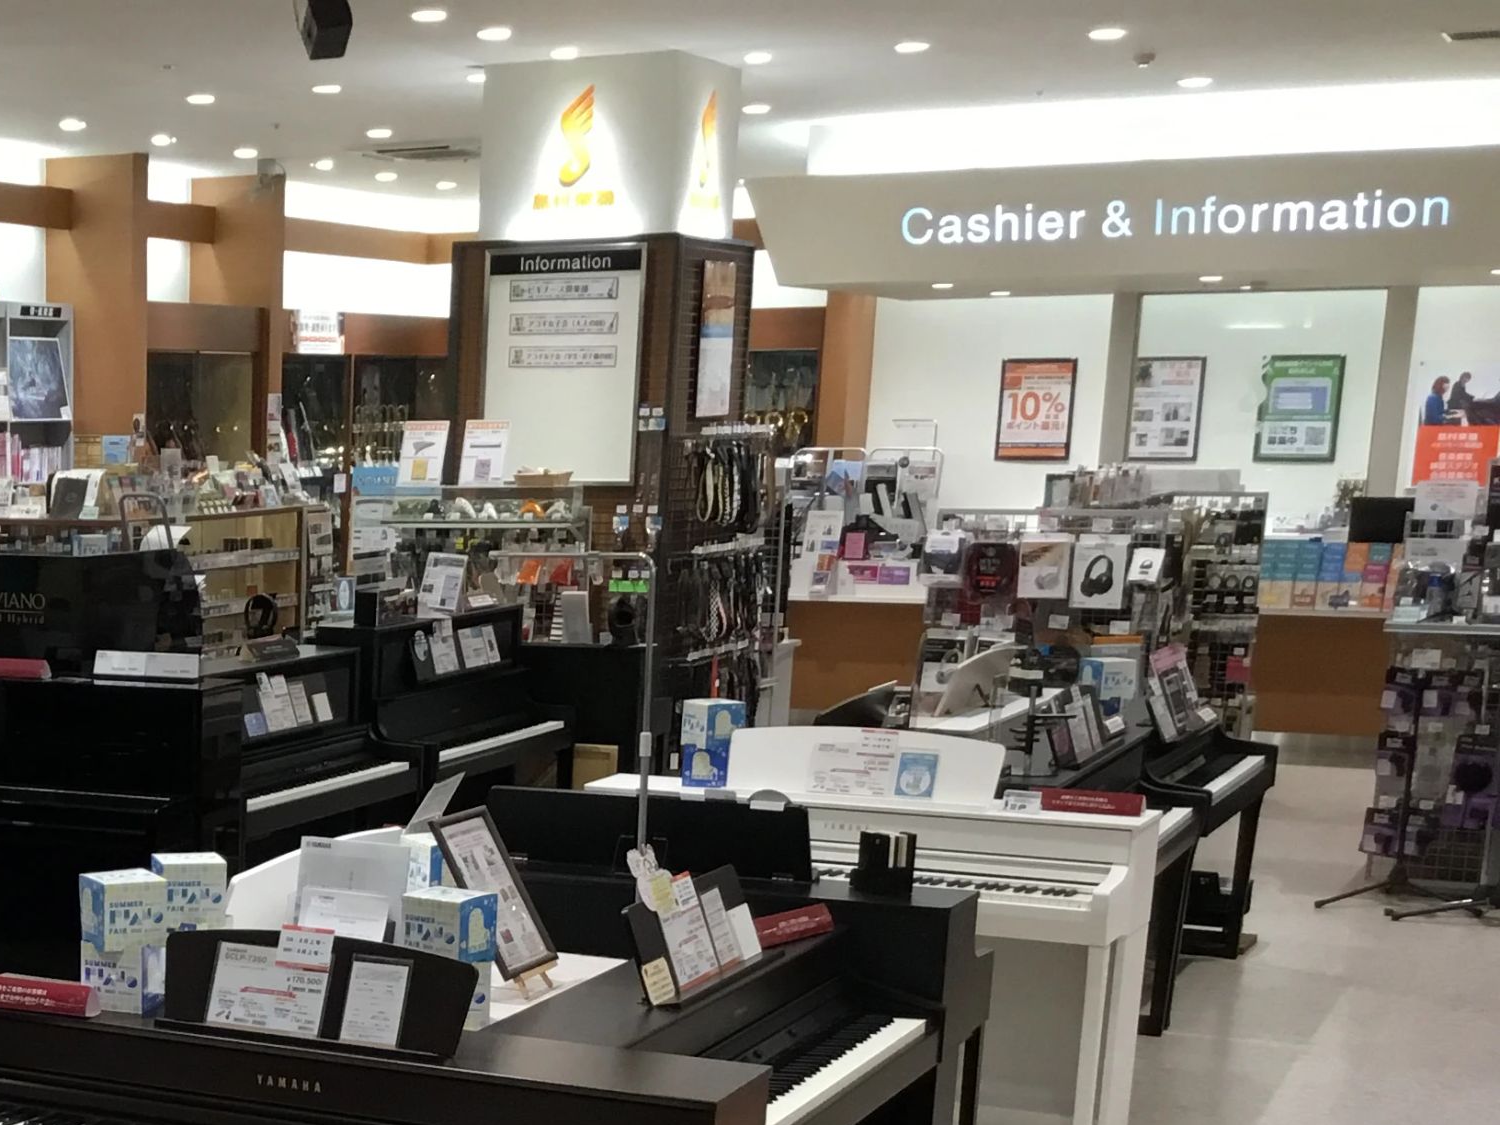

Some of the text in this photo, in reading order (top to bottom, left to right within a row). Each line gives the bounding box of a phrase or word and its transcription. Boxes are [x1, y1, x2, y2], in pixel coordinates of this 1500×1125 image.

[901, 188, 1450, 246] Cashier & Information
[520, 254, 612, 272] Information
[1007, 390, 1066, 421] 10%
[6, 612, 45, 625] Hybrid
[109, 900, 144, 909] SUMMER
[108, 927, 128, 936] FAIR
[84, 959, 118, 970] SUMMER
[256, 1073, 322, 1094] YAMAHA
